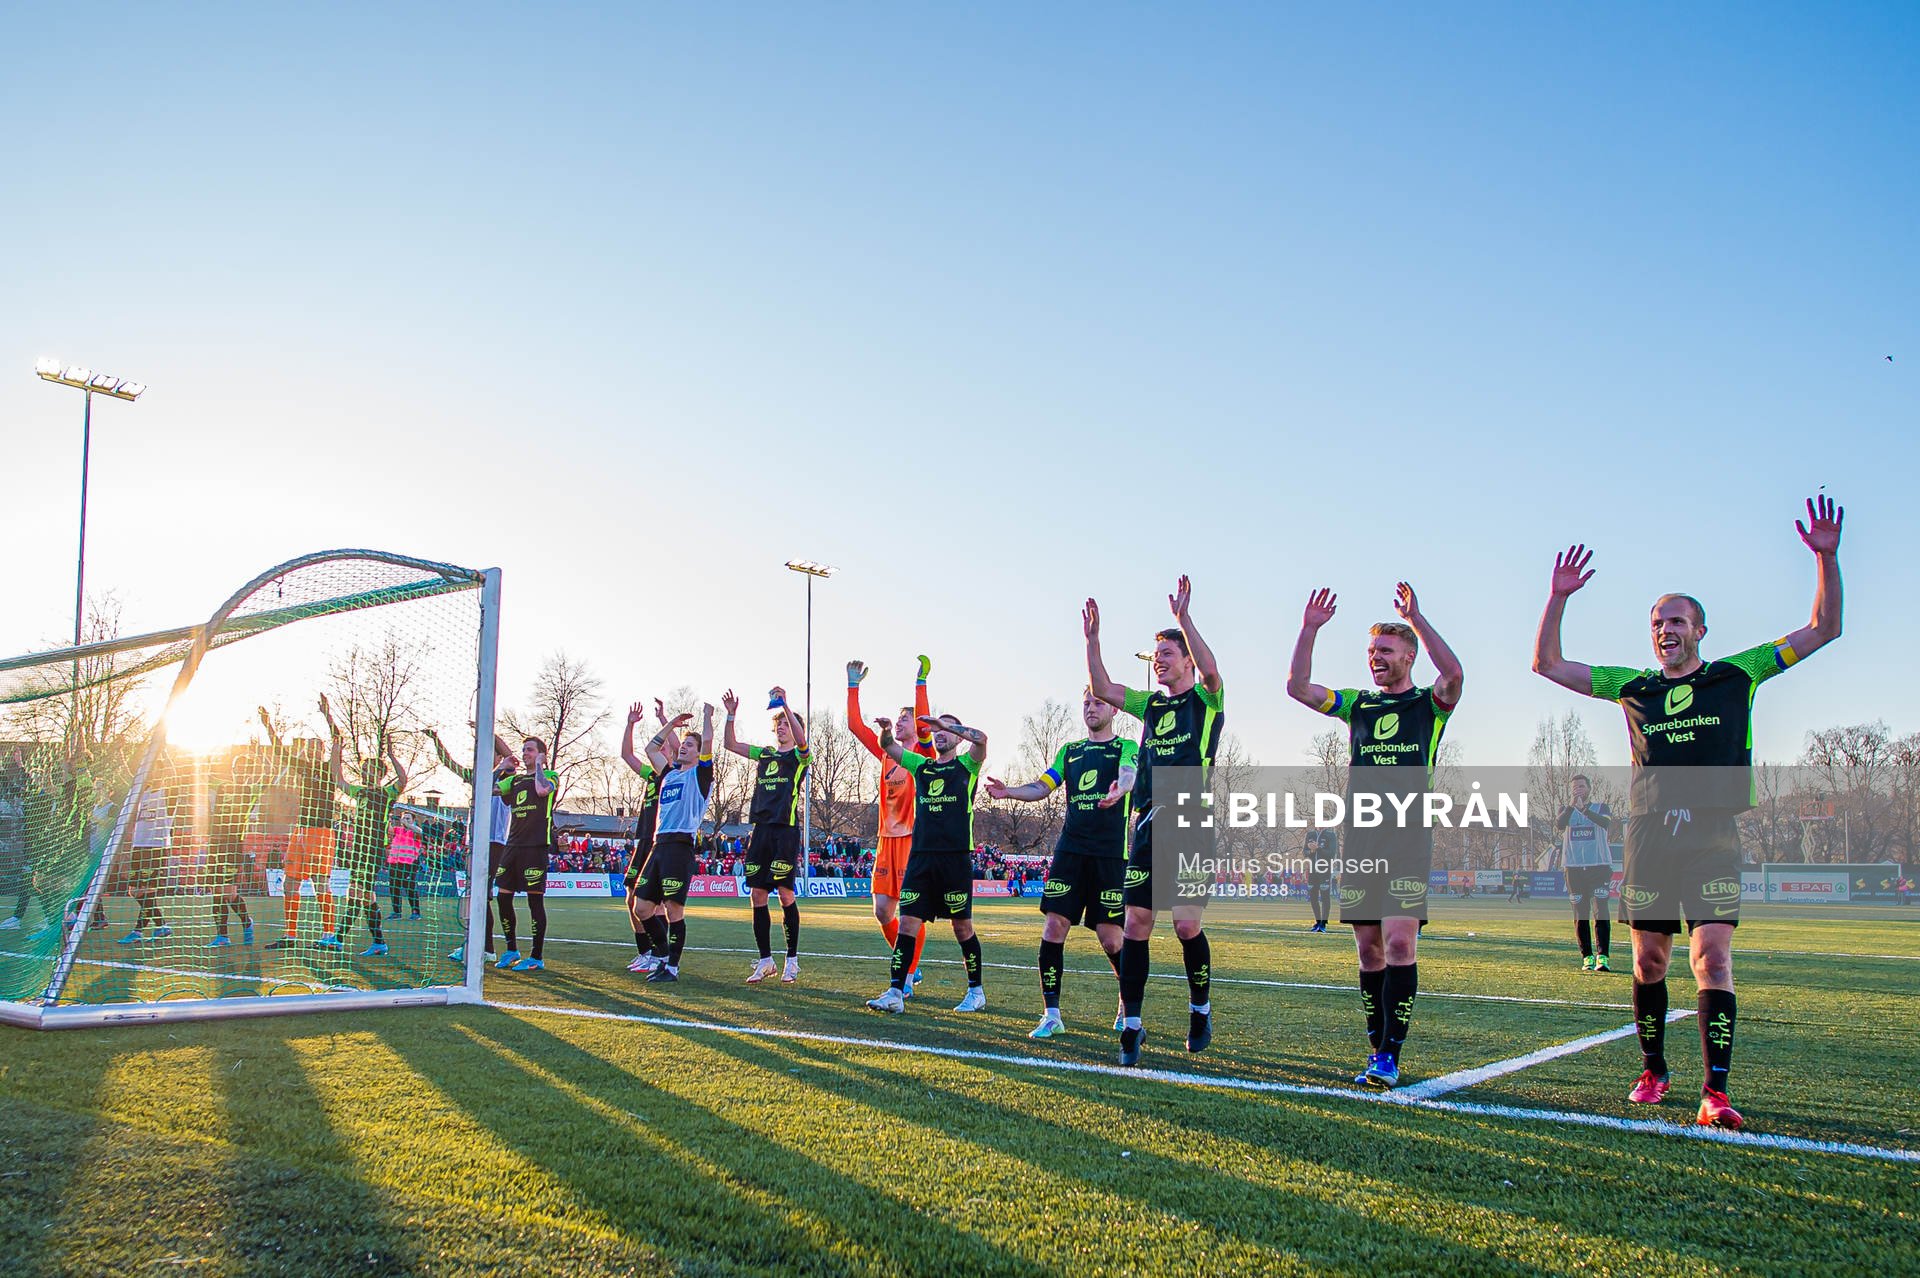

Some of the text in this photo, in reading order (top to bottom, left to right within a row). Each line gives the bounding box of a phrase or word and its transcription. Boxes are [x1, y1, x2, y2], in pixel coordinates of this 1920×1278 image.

[1642, 715, 1720, 735] Sparebanken
[1145, 732, 1191, 748] Sparebanken
[1666, 731, 1696, 743] Vest
[1156, 746, 1175, 755] Vest
[1360, 742, 1419, 756] parebanken
[1373, 755, 1397, 765] Vest
[1078, 803, 1094, 811] Vest
[1390, 880, 1427, 892] LERØY
[1790, 883, 1832, 892] SPAR
[944, 891, 968, 902] LERØY
[1100, 891, 1123, 901] LERØ
[1620, 885, 1657, 901] LERØY
[1395, 996, 1413, 1024] tide
[1638, 1014, 1656, 1040] tide
[1709, 1013, 1731, 1049] tide
